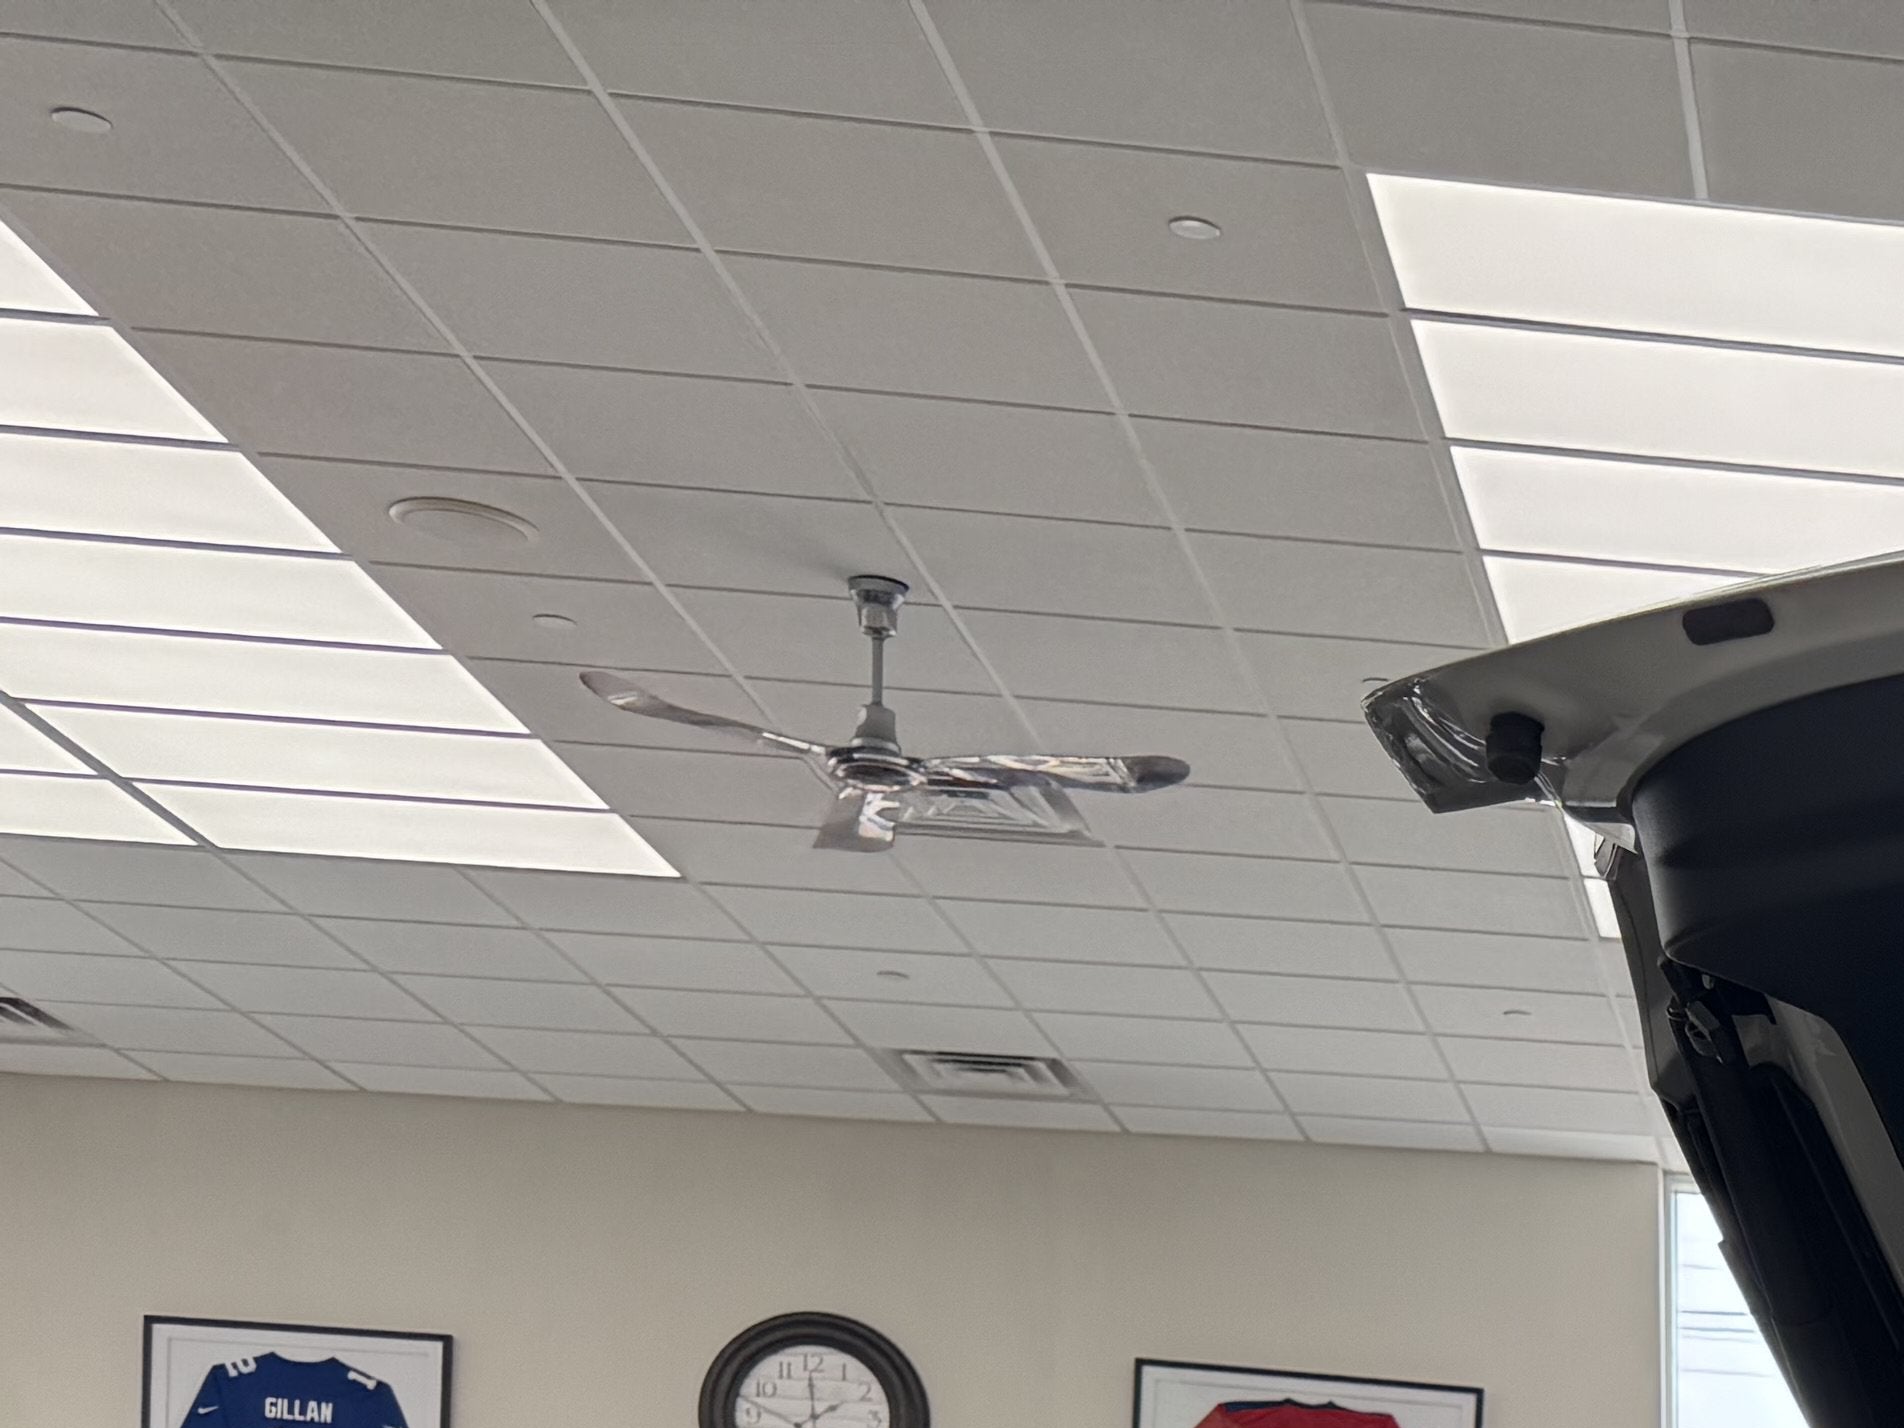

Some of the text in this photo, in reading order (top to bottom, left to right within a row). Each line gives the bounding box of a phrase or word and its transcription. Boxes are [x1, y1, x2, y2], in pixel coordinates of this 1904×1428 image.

[778, 1361, 792, 1380] 11
[802, 1354, 824, 1373] 12
[841, 1363, 847, 1381] 1
[755, 1381, 777, 1398] 10
[859, 1383, 873, 1401] 2
[264, 1397, 333, 1424] GILLAN
[746, 1407, 761, 1424] 9
[866, 1410, 882, 1428] 3
